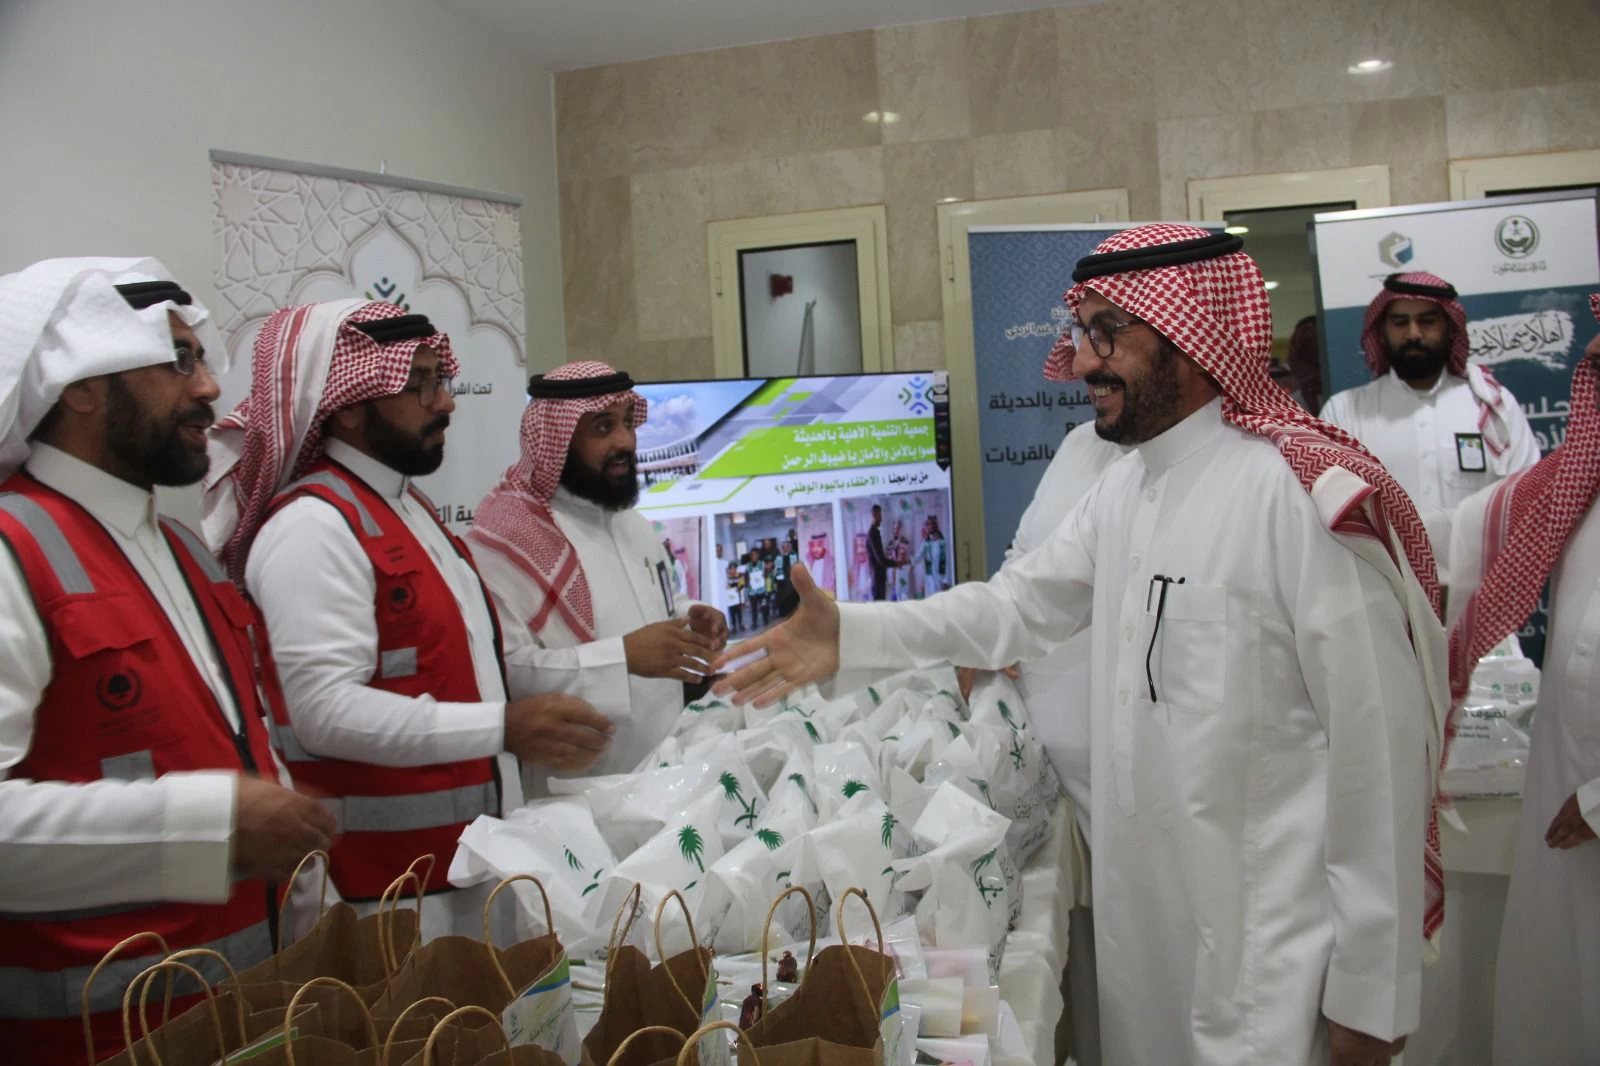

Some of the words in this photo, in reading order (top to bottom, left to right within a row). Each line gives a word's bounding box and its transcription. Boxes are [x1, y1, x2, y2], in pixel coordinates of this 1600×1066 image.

[472, 382, 493, 395] تحت
[989, 390, 1052, 412] بالحديثة
[793, 428, 836, 446] بالحديثة
[871, 424, 900, 441] التنمية
[903, 423, 929, 439] جمعية
